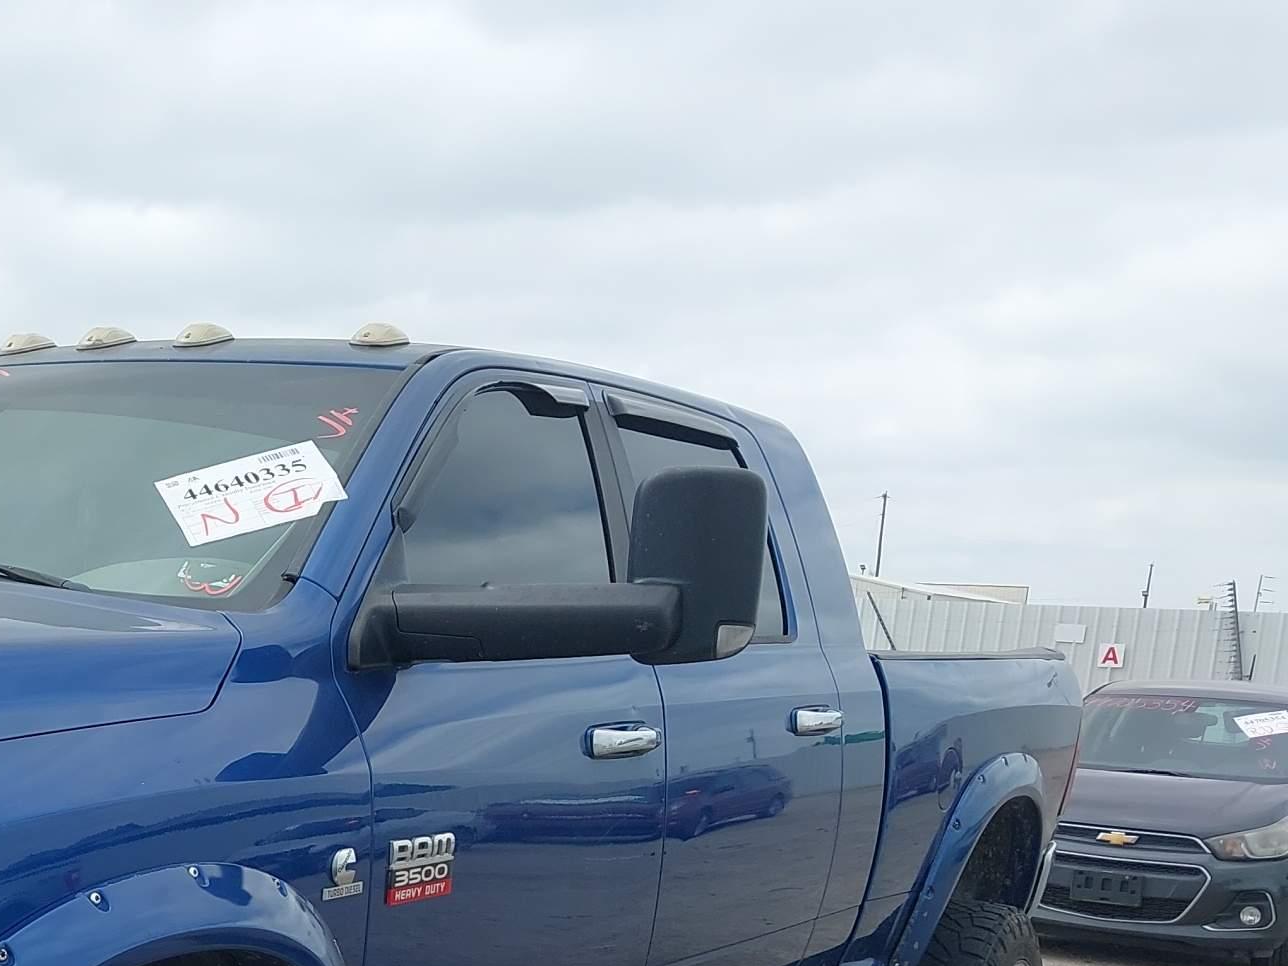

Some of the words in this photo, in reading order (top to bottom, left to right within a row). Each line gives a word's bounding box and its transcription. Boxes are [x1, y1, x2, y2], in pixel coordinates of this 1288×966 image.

[183, 457, 308, 501] 44640335
[1100, 646, 1119, 665] A
[390, 832, 456, 866] RAM
[394, 863, 449, 887] 3500
[394, 884, 423, 901] HEAVY
[424, 881, 446, 896] DUTY
